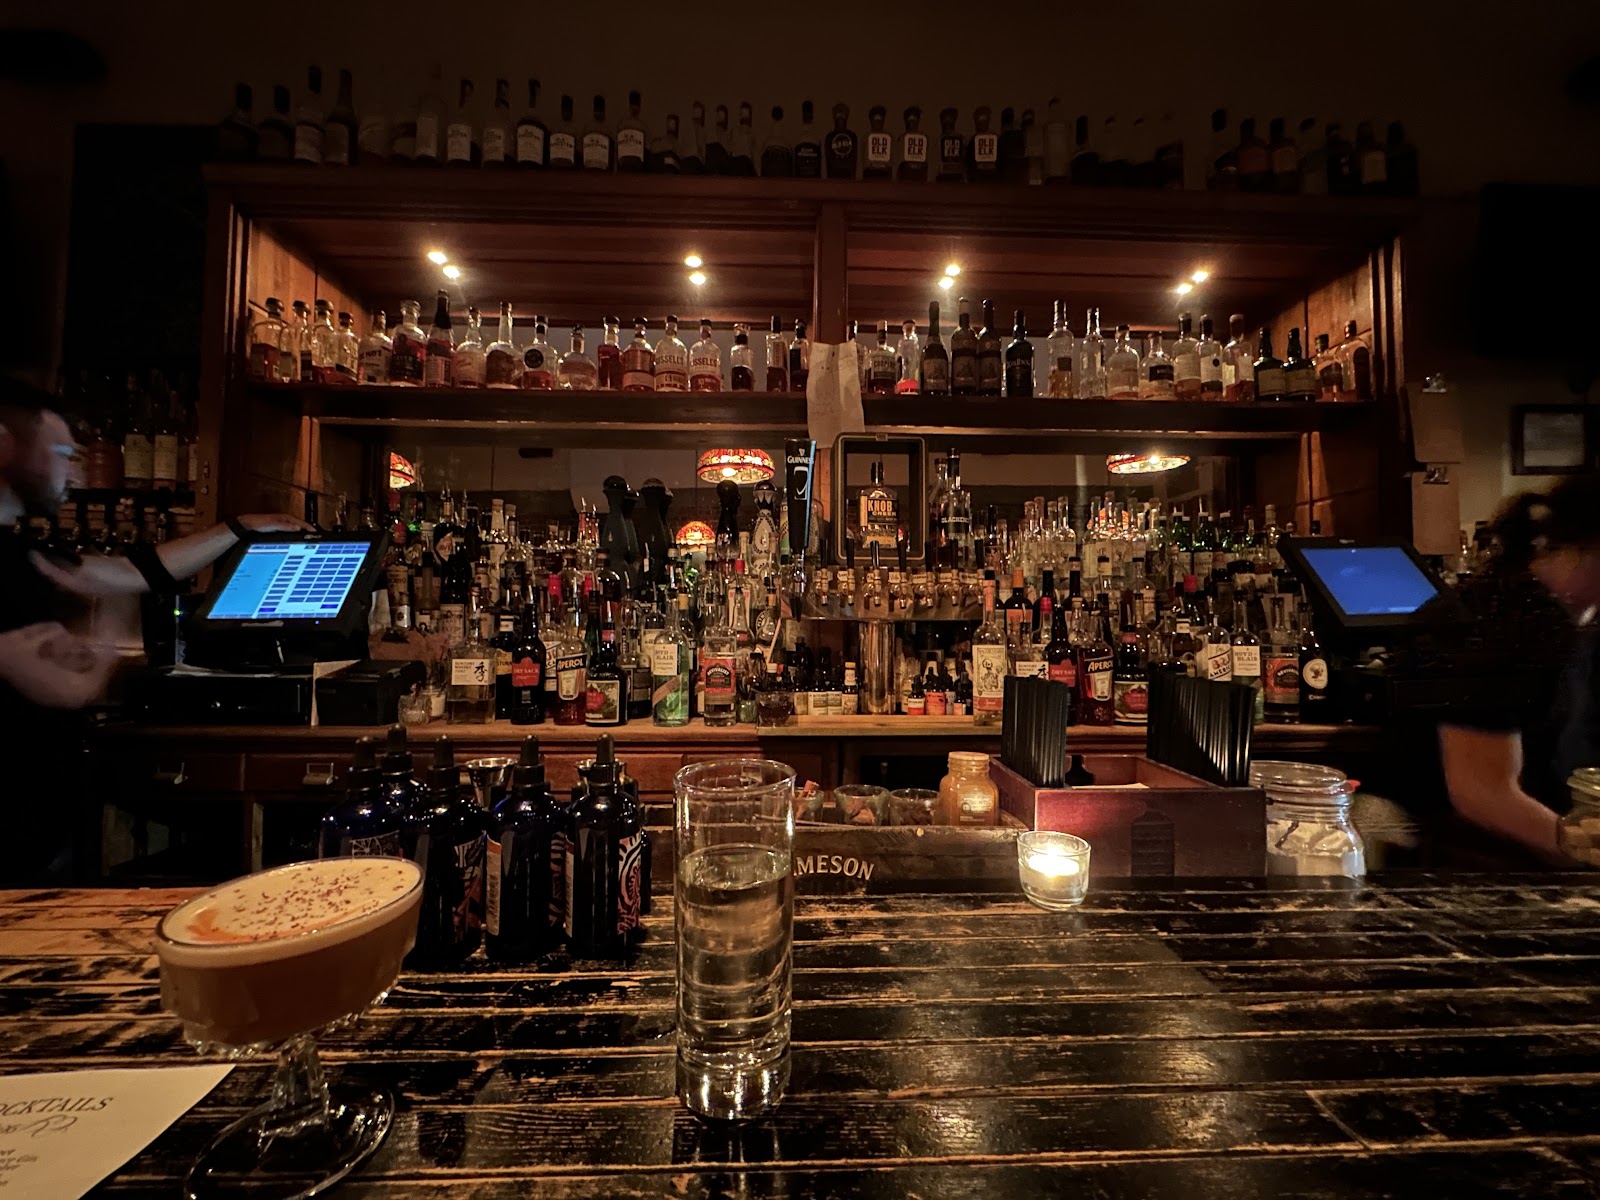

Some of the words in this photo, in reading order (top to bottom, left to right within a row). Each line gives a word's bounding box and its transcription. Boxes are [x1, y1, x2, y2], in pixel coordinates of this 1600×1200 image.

[871, 136, 888, 145] OLD
[907, 137, 923, 146] OLD
[944, 138, 960, 147] OLD
[978, 138, 994, 147] OLD
[871, 146, 888, 155] ELK
[907, 147, 923, 156] ELK
[944, 147, 960, 157] ELK
[978, 147, 994, 156] ELK
[867, 499, 893, 512] KNOB
[557, 658, 584, 671] APEROL
[793, 854, 875, 880] MESON
